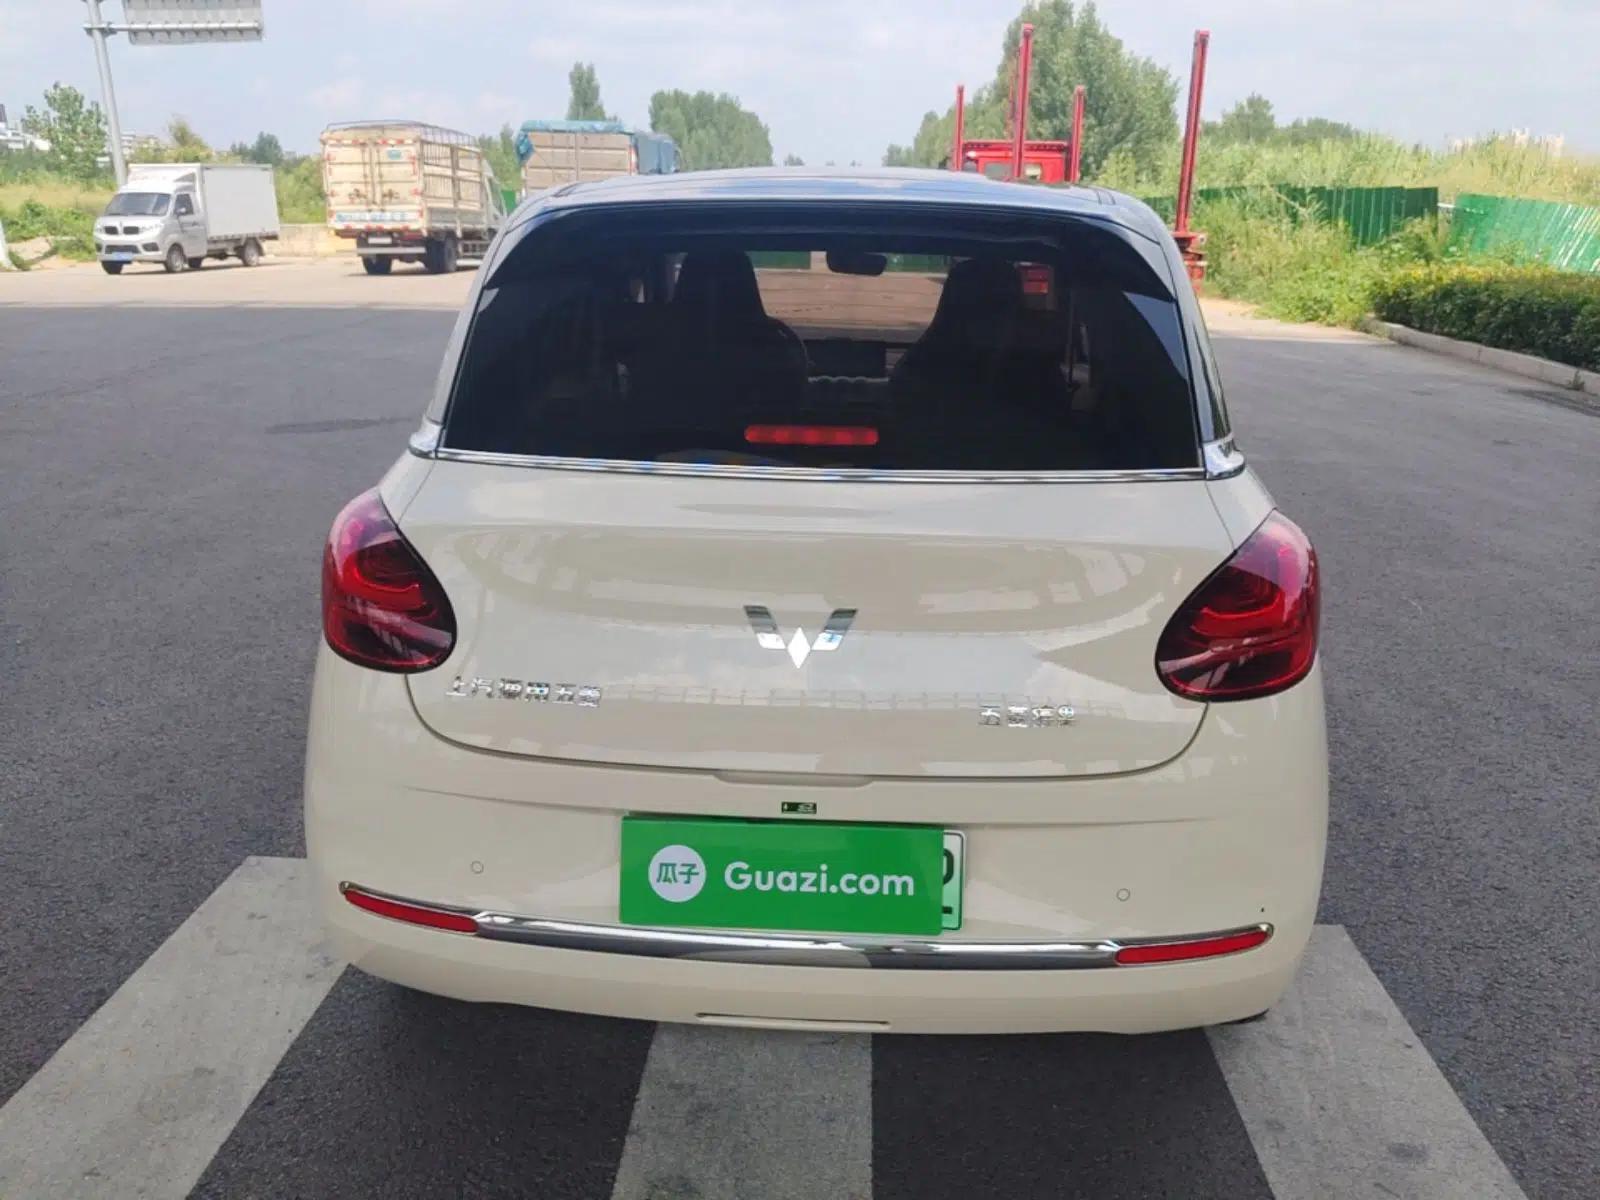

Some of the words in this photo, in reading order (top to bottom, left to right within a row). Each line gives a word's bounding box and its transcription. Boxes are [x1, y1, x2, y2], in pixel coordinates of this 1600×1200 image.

[446, 675, 601, 708] 上汽通用五菱
